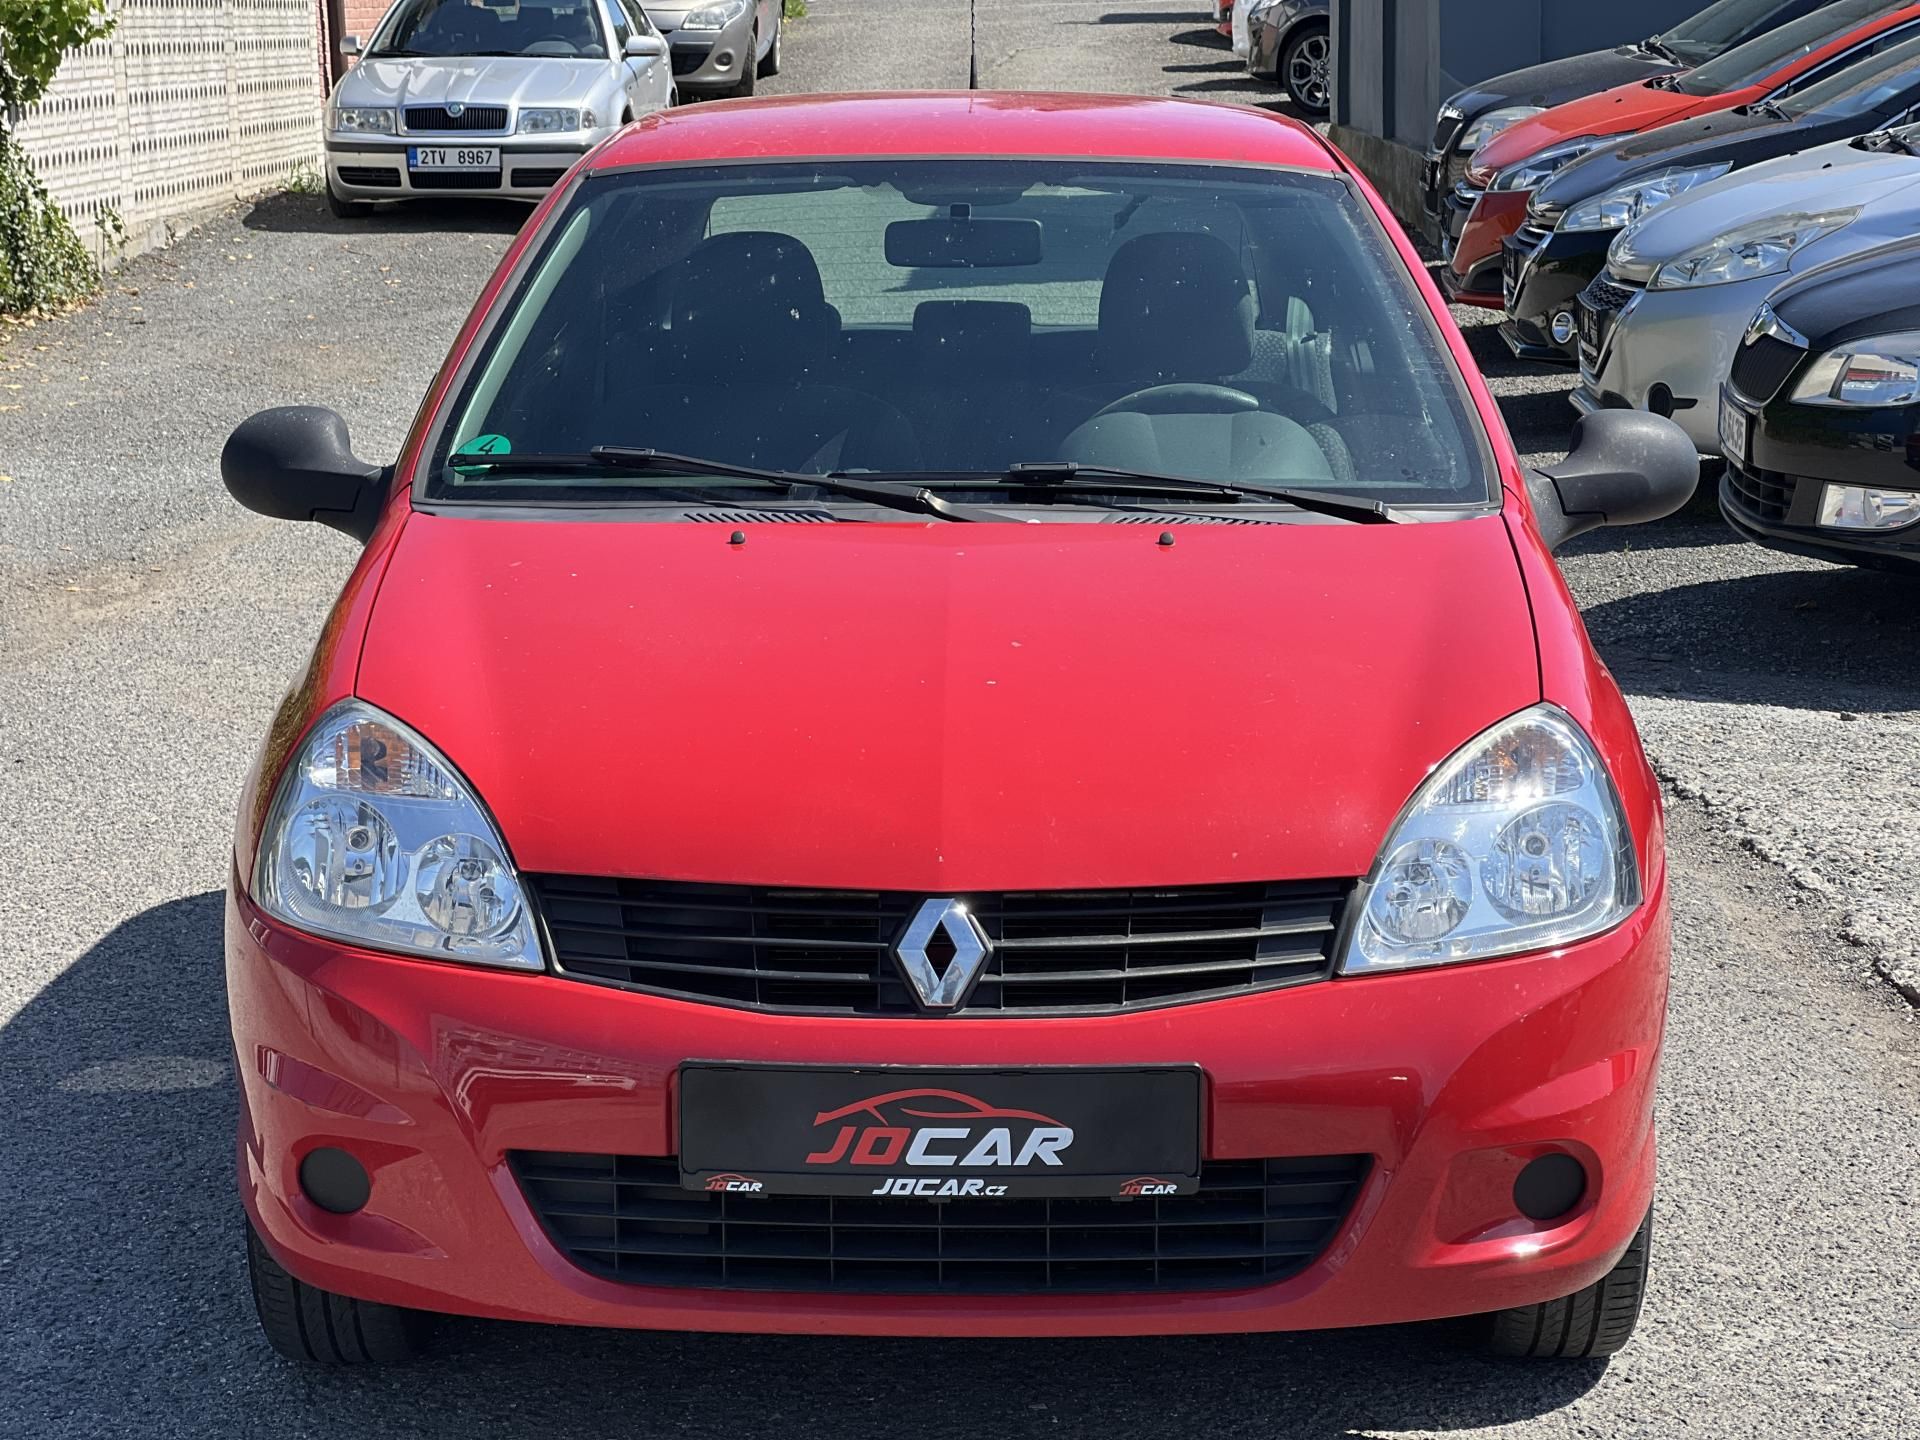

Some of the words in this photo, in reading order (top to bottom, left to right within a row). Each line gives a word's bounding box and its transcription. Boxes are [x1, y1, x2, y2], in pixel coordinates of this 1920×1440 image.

[420, 149, 446, 165] 2TV
[457, 149, 493, 165] 8967
[477, 436, 499, 454] 4
[805, 1125, 1075, 1166] JOCAR
[704, 1181, 764, 1192] JOCAR
[1119, 1184, 1178, 1196] JOCAR
